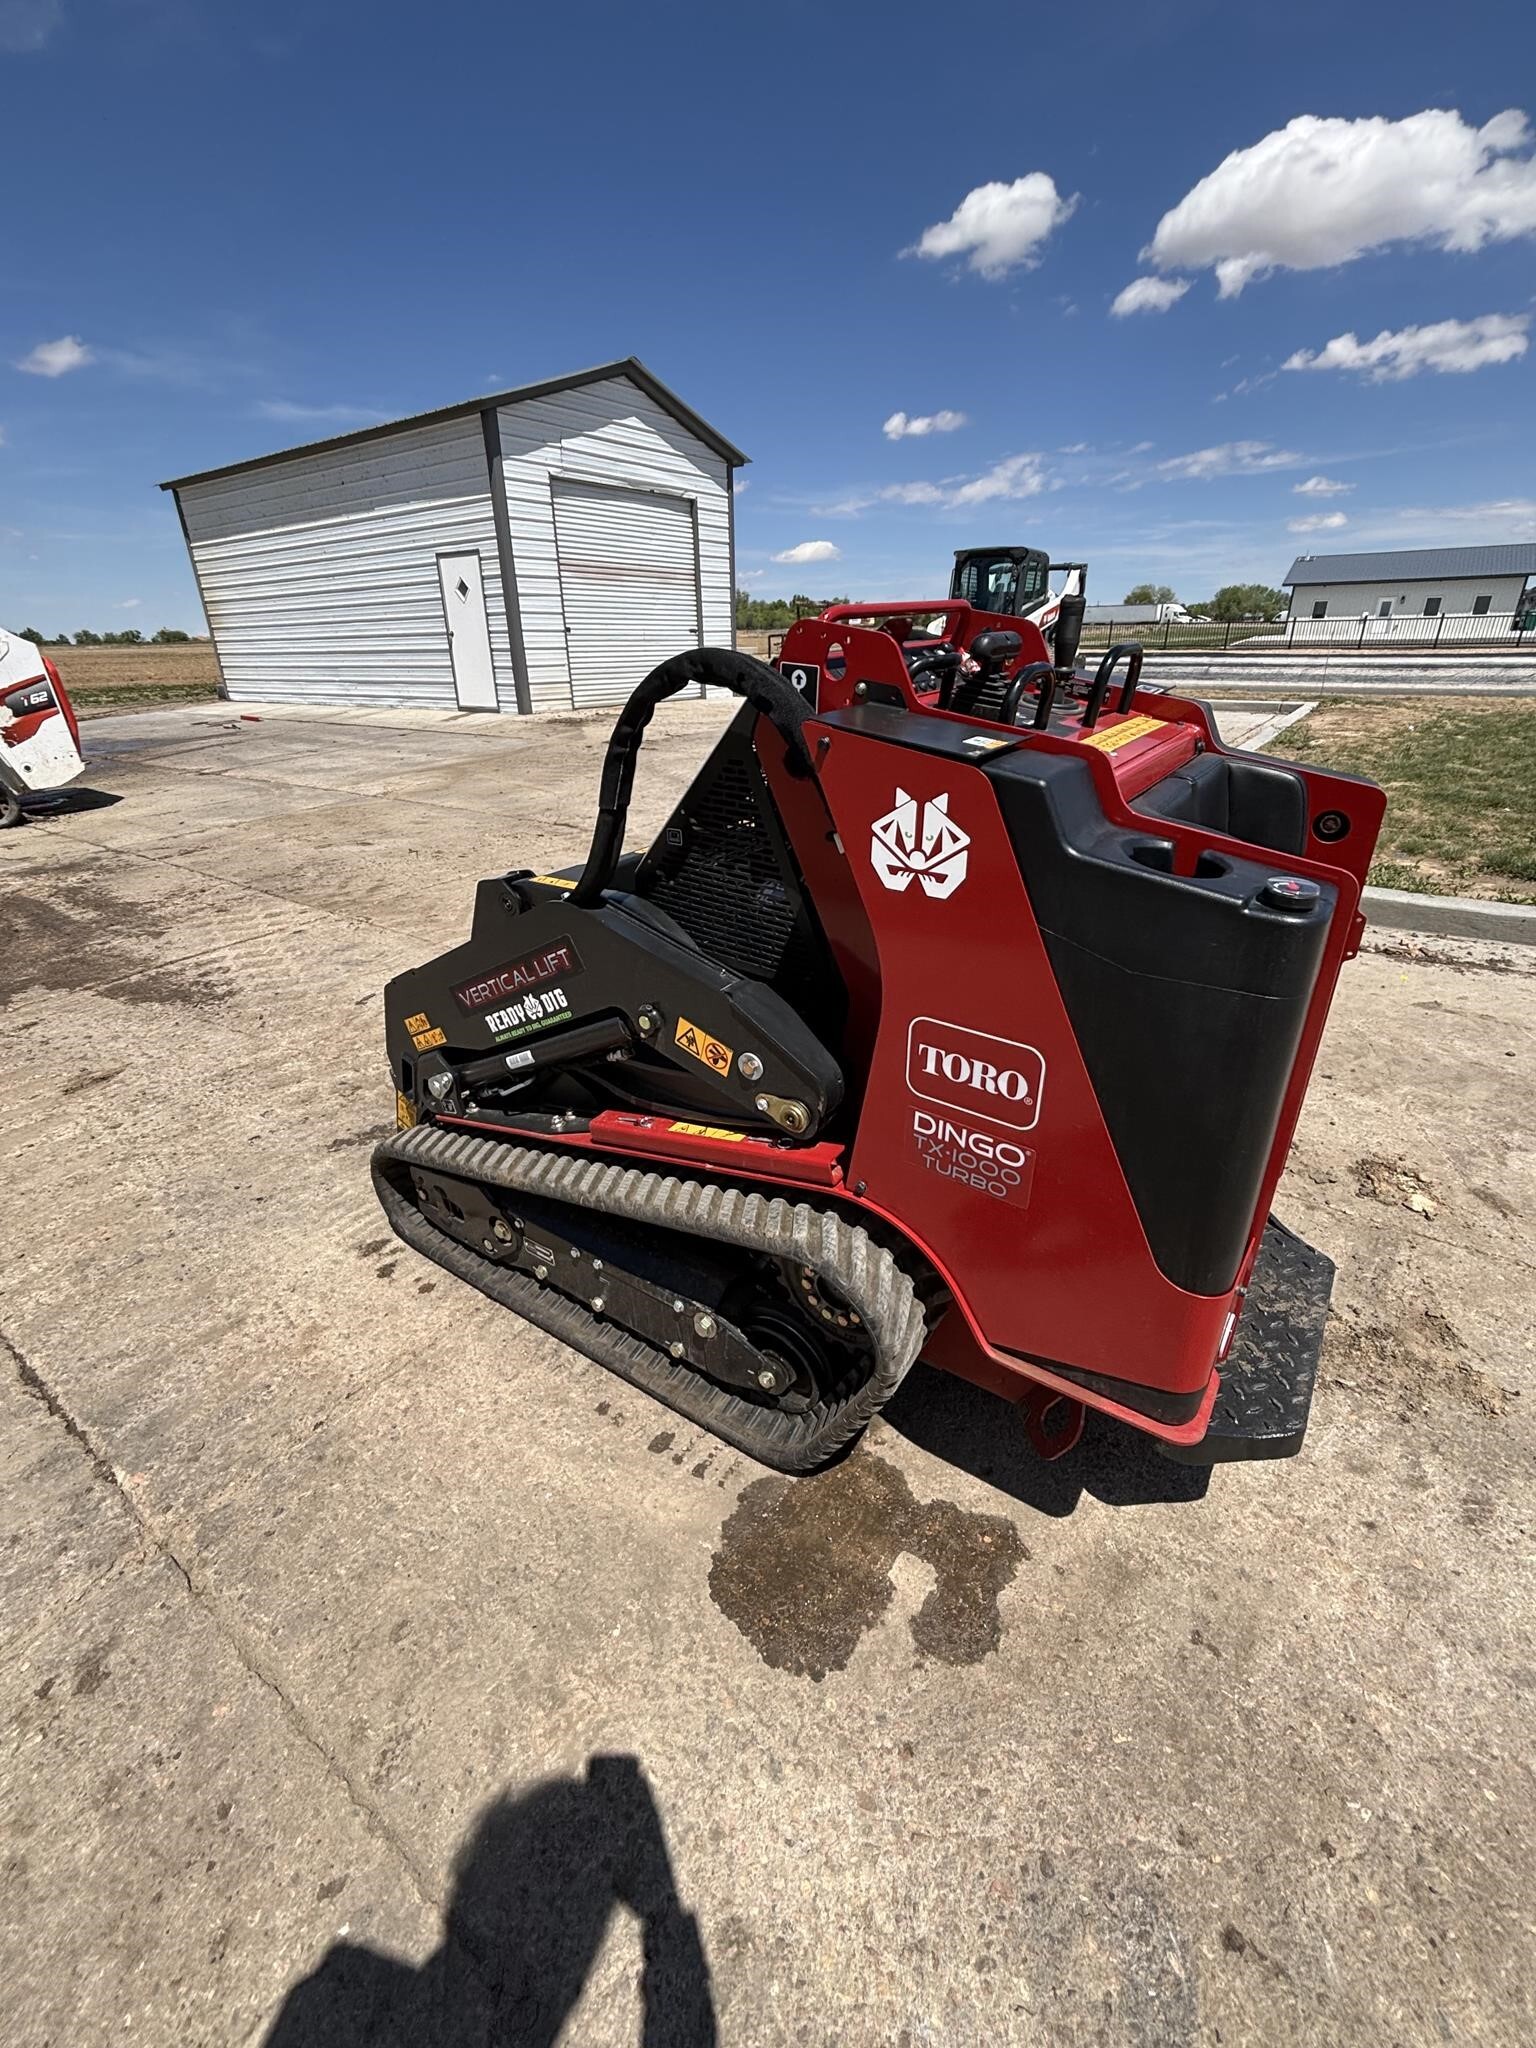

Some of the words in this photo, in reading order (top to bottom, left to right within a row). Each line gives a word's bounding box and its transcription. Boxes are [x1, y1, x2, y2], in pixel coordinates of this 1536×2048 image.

[458, 966, 536, 1007] VERTICAL
[534, 948, 571, 977] LIFT
[484, 1003, 527, 1033] READY
[540, 988, 569, 1013] DIG
[918, 1043, 1029, 1101] TORO
[913, 1110, 1026, 1168] DINGO
[922, 1153, 1007, 1197] TURBO
